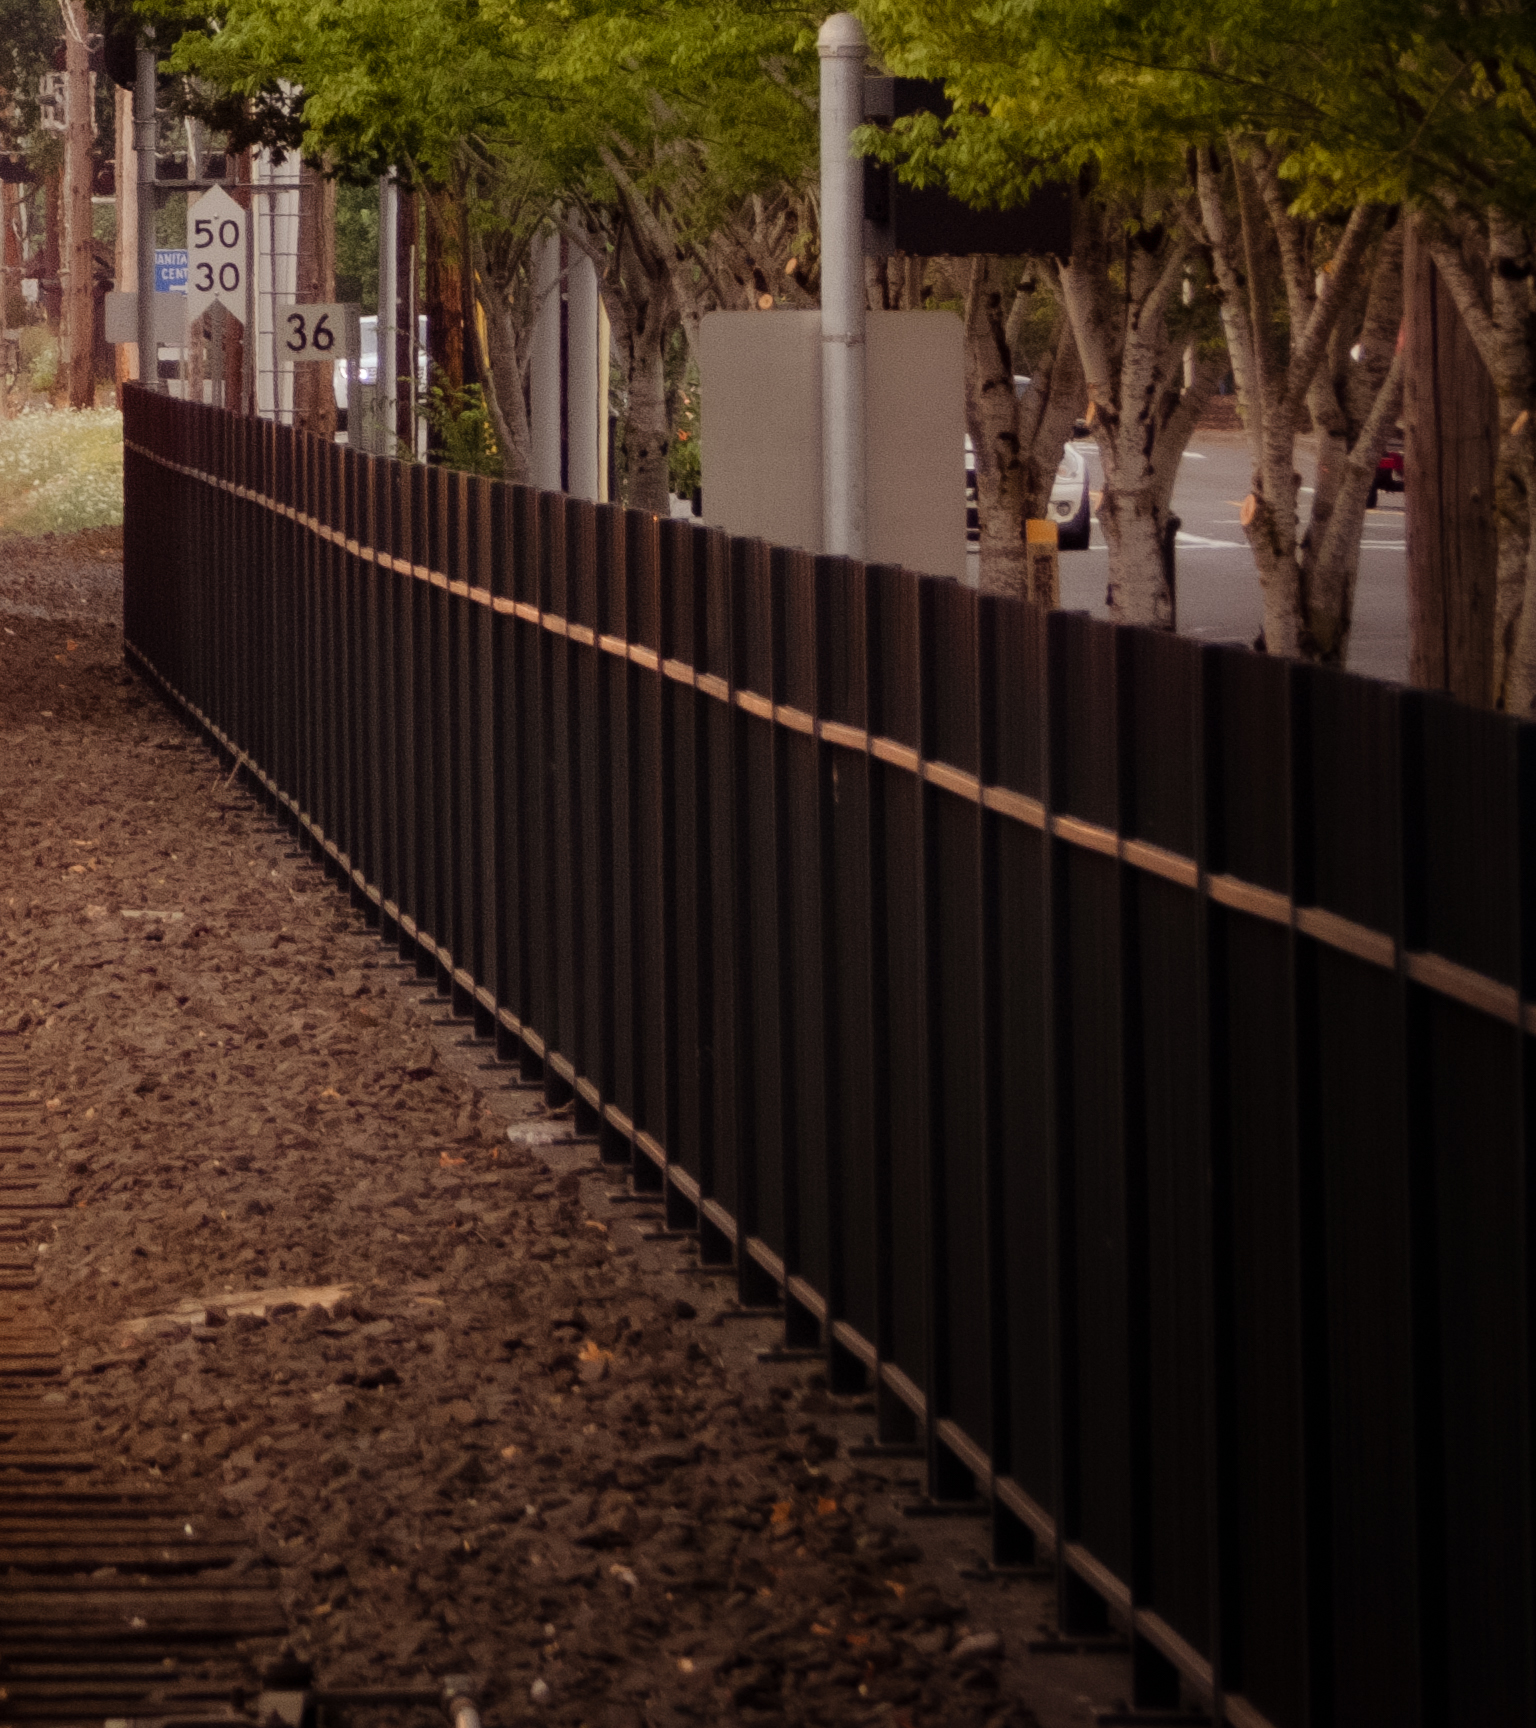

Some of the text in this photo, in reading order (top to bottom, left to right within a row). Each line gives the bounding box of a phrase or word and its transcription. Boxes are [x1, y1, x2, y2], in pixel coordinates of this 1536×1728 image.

[194, 219, 240, 249] 50
[194, 262, 240, 292] 30
[286, 313, 335, 352] 36
